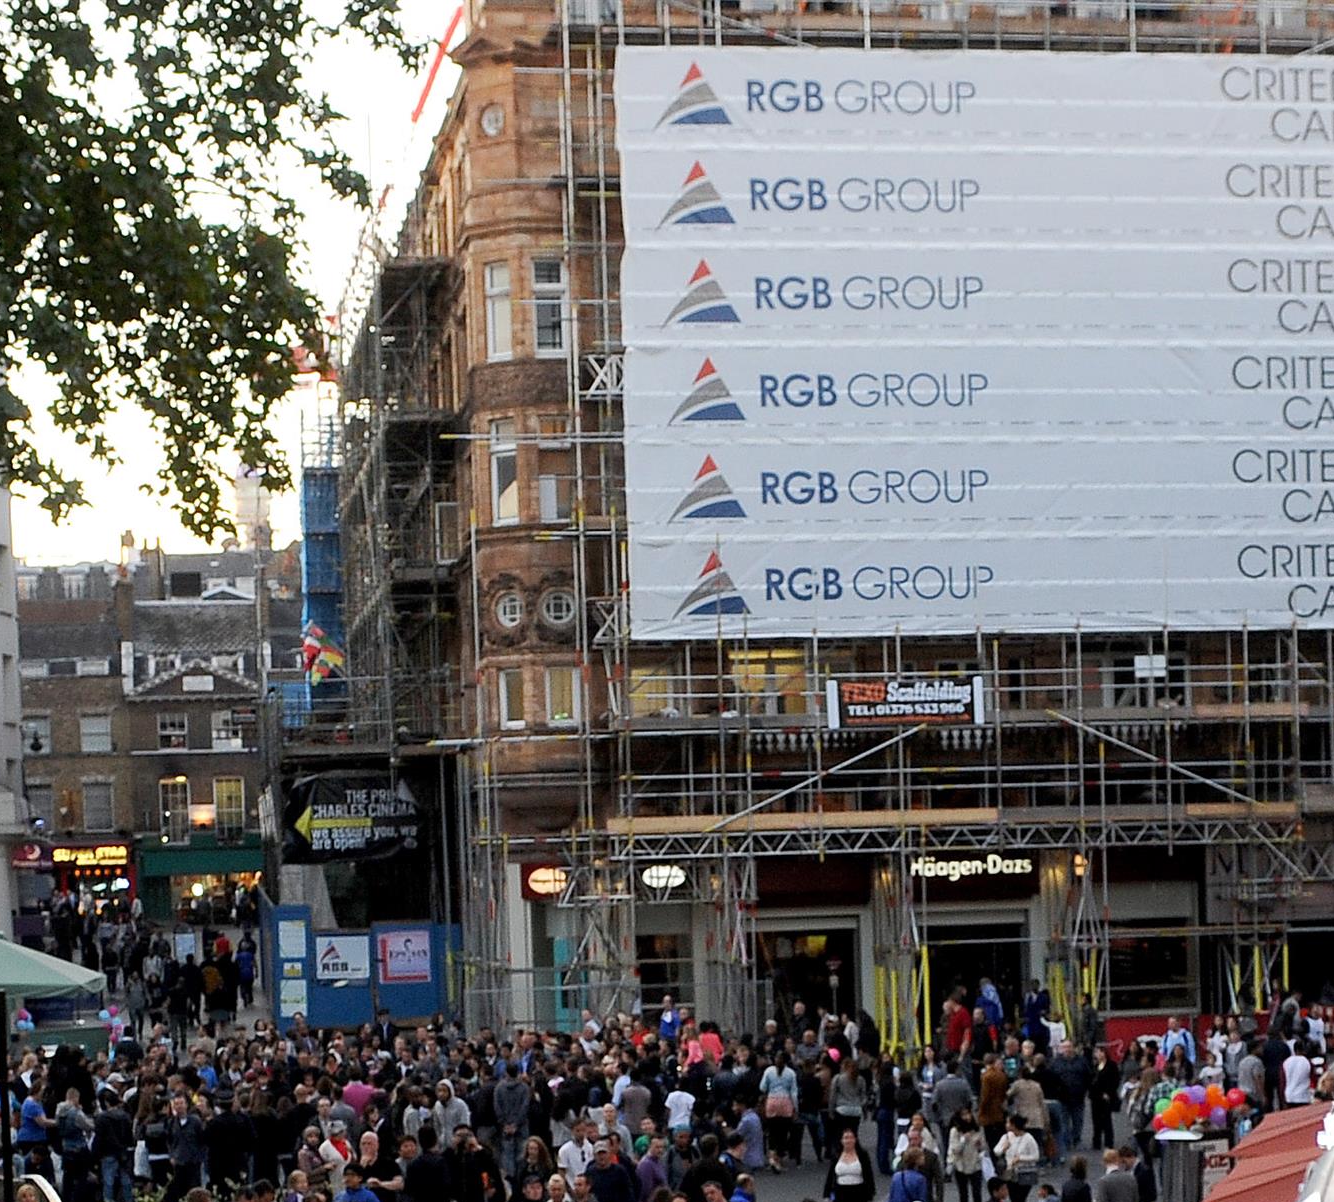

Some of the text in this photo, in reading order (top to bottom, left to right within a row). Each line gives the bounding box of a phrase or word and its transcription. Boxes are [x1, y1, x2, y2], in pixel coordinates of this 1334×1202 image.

[746, 79, 976, 115] RGB GROUP
[749, 177, 980, 213] RGB GROUP
[754, 275, 984, 311] RGB GROUP
[759, 372, 989, 408] RGB GROUP
[760, 469, 989, 505] RGB GROUP
[765, 565, 994, 602] RGB GROUP
[848, 704, 875, 716] TEL:
[886, 680, 972, 704] Scaffolding
[312, 803, 417, 818] CHARLES CINEMA
[344, 789, 368, 804] THE
[311, 827, 330, 839] we
